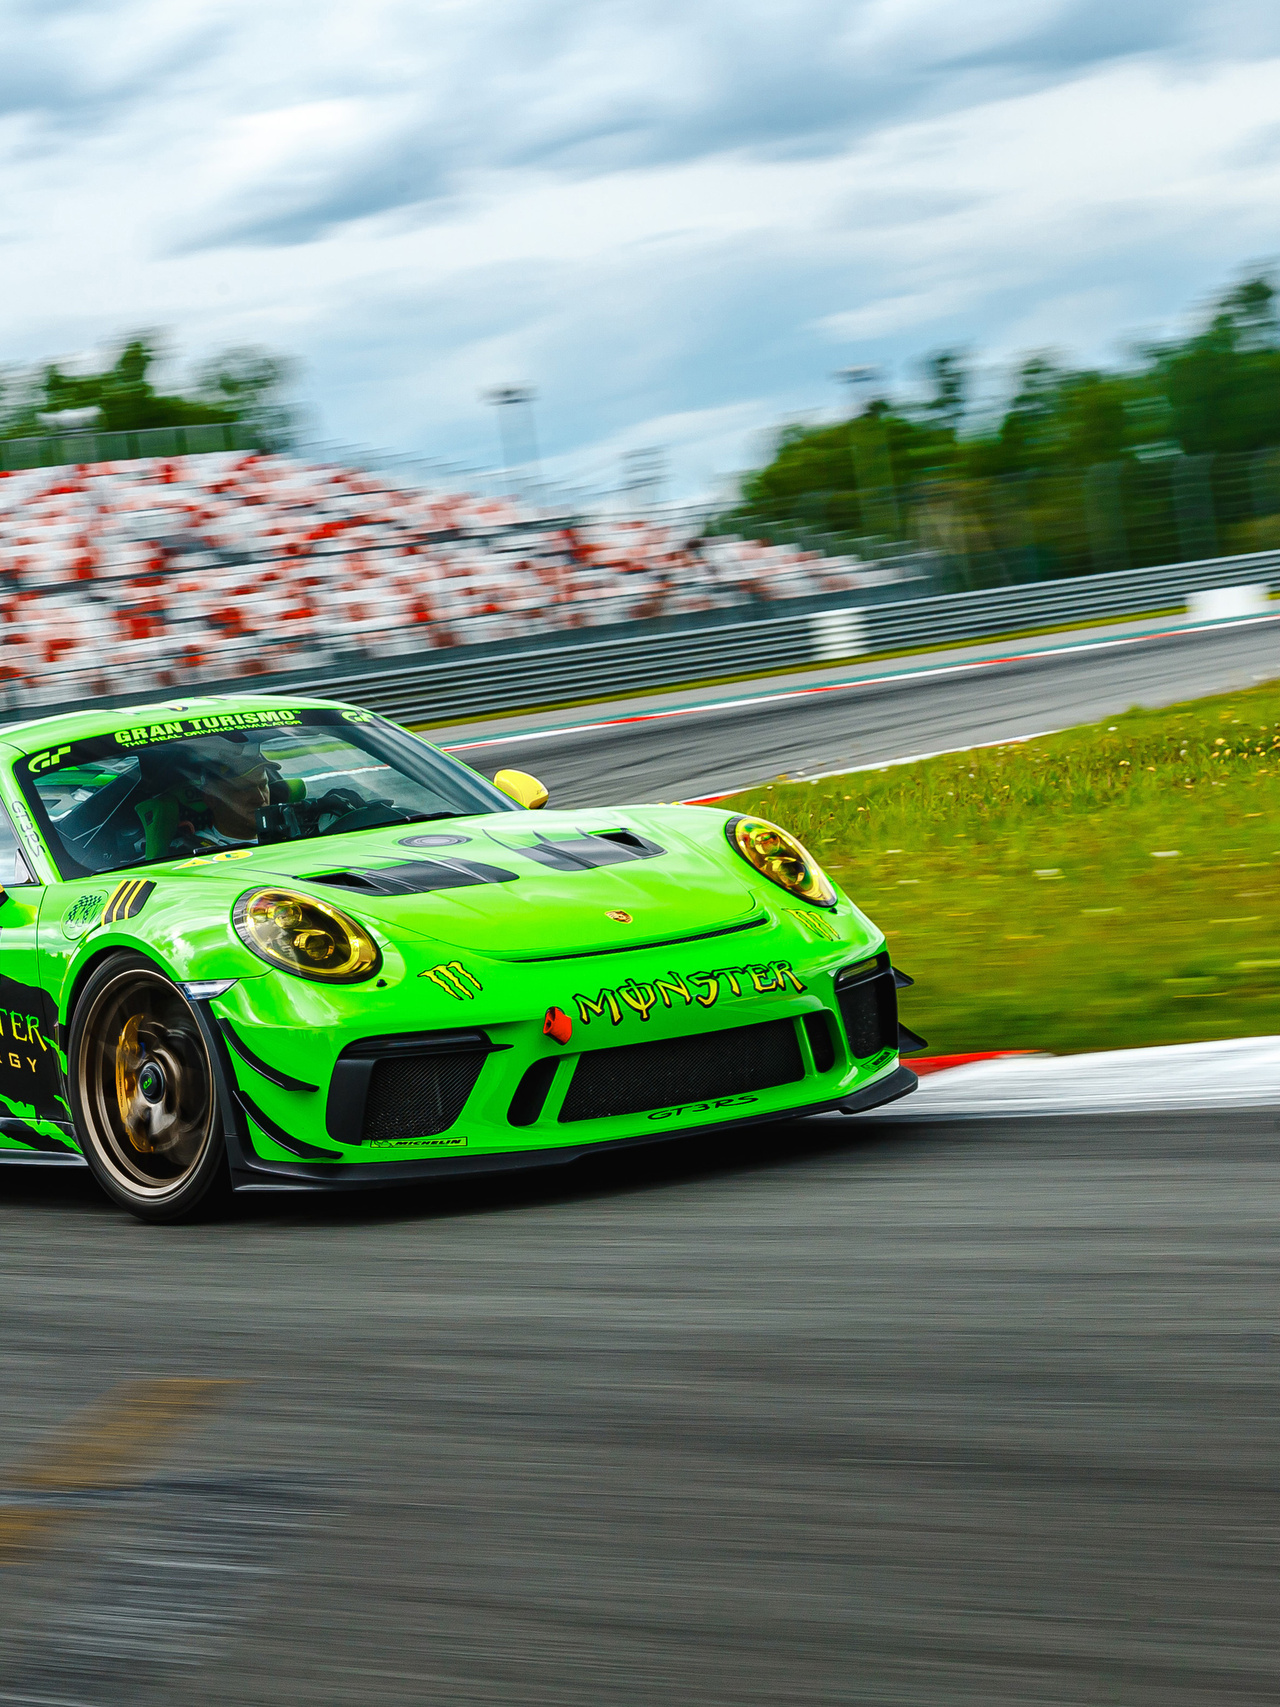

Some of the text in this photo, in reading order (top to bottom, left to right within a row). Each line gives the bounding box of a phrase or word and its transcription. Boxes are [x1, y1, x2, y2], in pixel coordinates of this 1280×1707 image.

[114, 721, 183, 744] GRAN
[122, 720, 302, 748] THE REAL DRIVING SIMULATOR
[573, 959, 808, 1026] MONSTER
[647, 1095, 759, 1121] GT3RS
